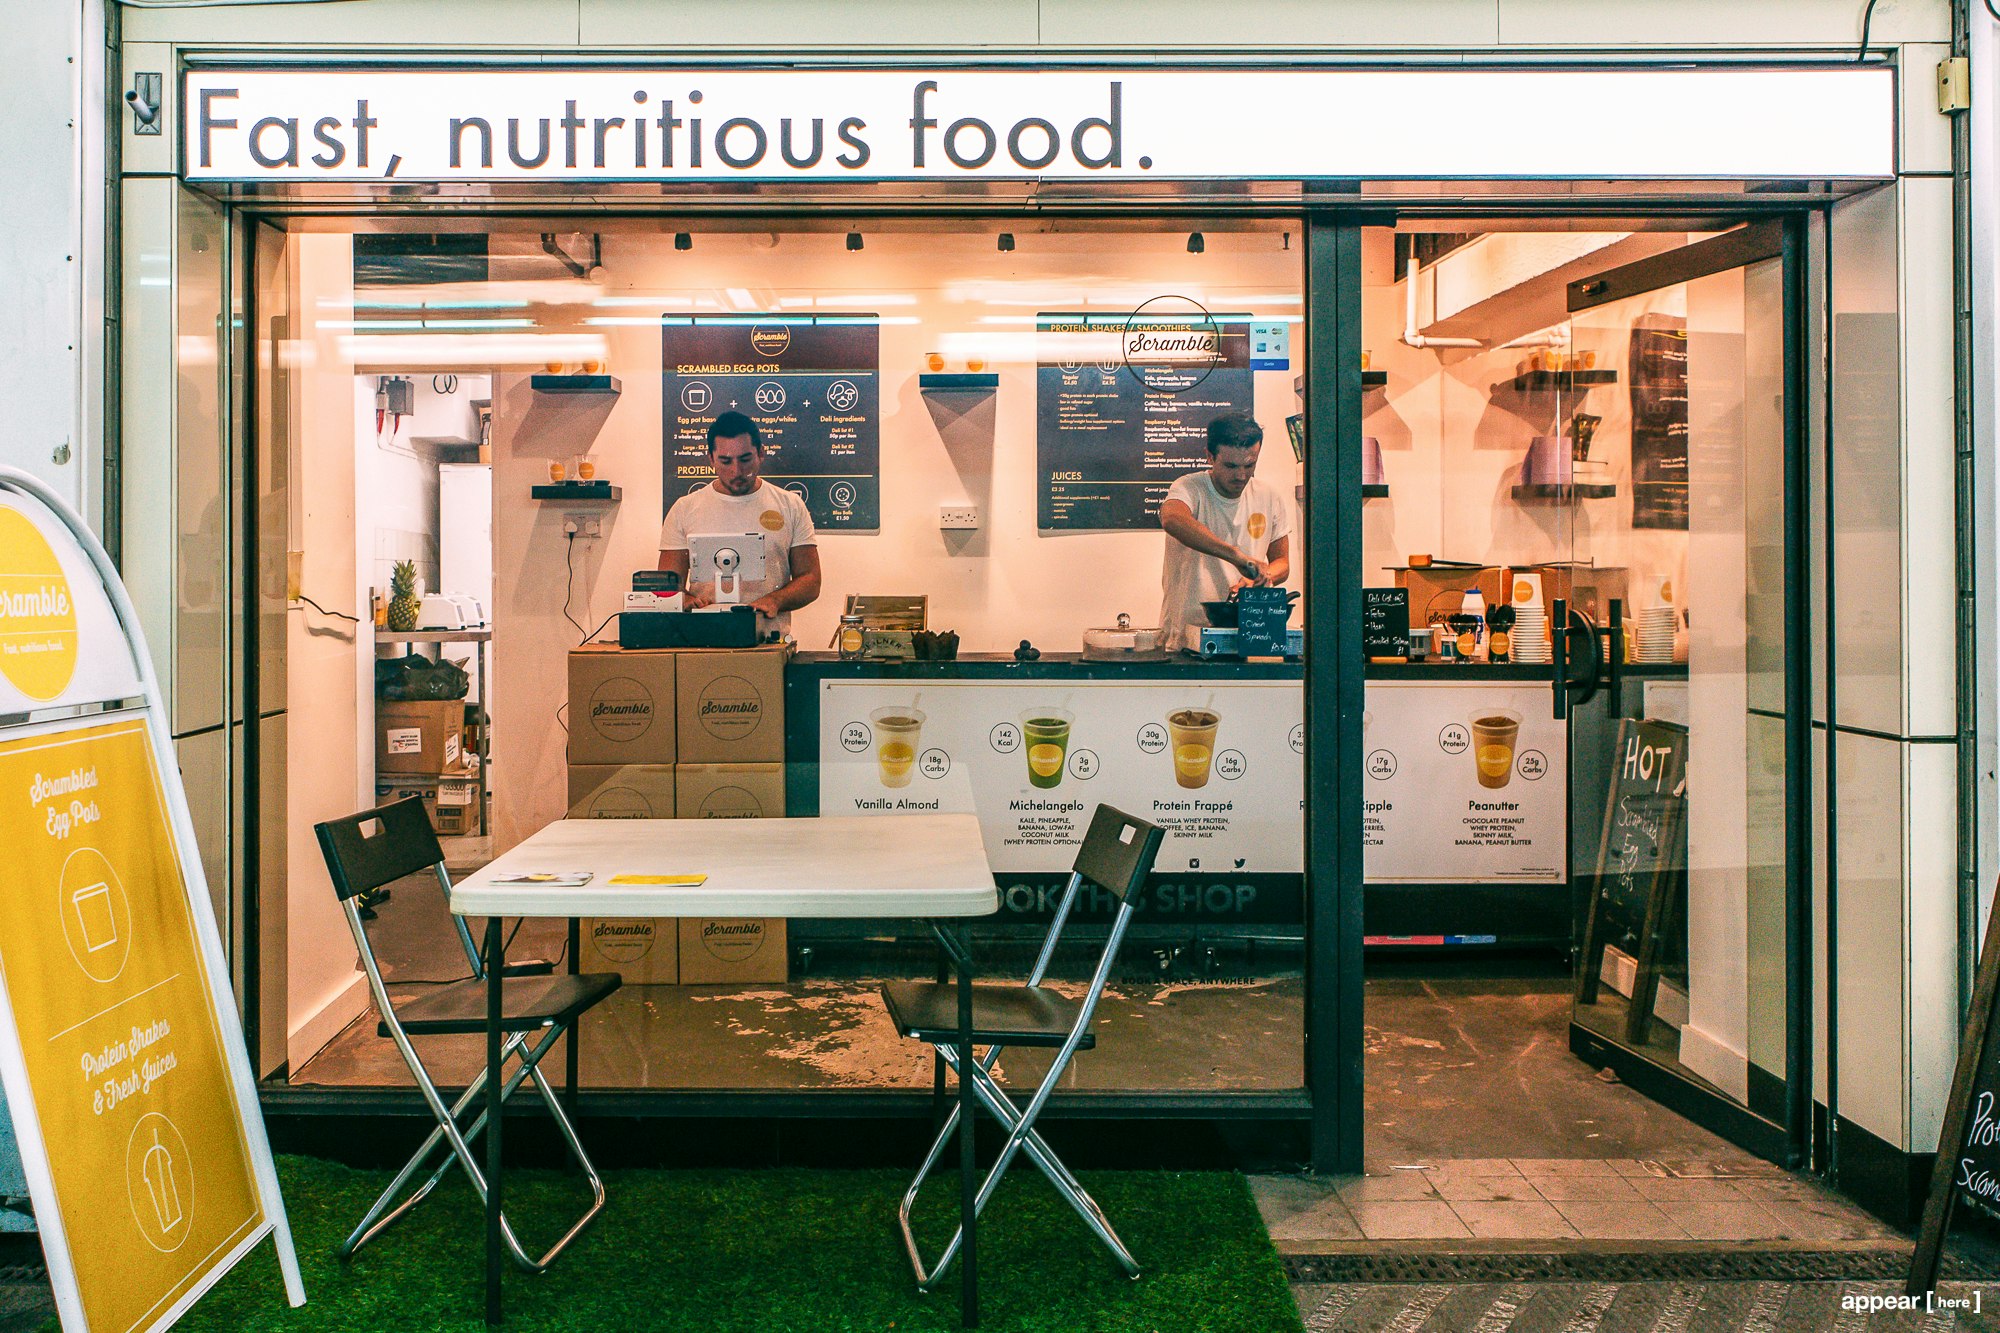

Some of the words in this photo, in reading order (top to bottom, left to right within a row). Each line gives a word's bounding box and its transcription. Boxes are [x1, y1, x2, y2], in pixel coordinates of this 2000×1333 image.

[200, 88, 402, 177] Fast,
[449, 91, 871, 169] nutritious
[909, 80, 1153, 170] food.
[1050, 324, 1089, 333] PROTEIN
[1091, 324, 1126, 333] SHAKES
[1137, 324, 1191, 332] SMOOTHIES
[1129, 333, 1214, 356] Scramble
[677, 364, 731, 374] SCRAMBLED
[733, 364, 754, 373] EGG
[756, 364, 780, 373] POTS
[677, 416, 689, 424] Egg
[691, 416, 701, 424] pot
[761, 415, 798, 424] eggs/whites
[833, 415, 866, 424] ingredients
[677, 466, 716, 475] PROTEIN
[1051, 471, 1082, 480] JUICES
[592, 702, 651, 717] Scramble
[702, 701, 759, 716] Scramble
[849, 729, 863, 739] 33g
[1145, 731, 1160, 740] 30g
[1448, 732, 1462, 740] 41g
[929, 756, 942, 764] 18g
[1079, 757, 1089, 765] 3g
[1225, 757, 1238, 766] 16g
[1376, 757, 1389, 766] 17g
[1525, 758, 1540, 766] 25g
[1623, 734, 1672, 793] HOT
[29, 765, 99, 809] Scrambled
[398, 790, 435, 799] SOLO
[855, 798, 893, 809] Vanilla
[896, 798, 939, 809] Almond
[1009, 799, 1084, 813] Michelangelo
[1153, 800, 1191, 810] Protein
[1194, 800, 1233, 813] Frappé
[1468, 800, 1520, 811] Peanutter
[46, 806, 72, 840] Egg
[70, 800, 101, 828] Pots
[1618, 795, 1660, 847] Scrambled
[1156, 883, 1257, 913] SHOP
[594, 923, 652, 937] Scramble
[704, 922, 762, 936] Scramble
[1164, 978, 1195, 986] SPACE,
[1198, 977, 1256, 985] ANYWHERE
[81, 1040, 128, 1082] Protein
[128, 1019, 171, 1062] Shakes
[93, 1089, 104, 1115] &
[104, 1069, 141, 1110] Fresh
[141, 1051, 178, 1095] Juices
[1968, 1091, 2000, 1148] Prot
[1956, 1157, 2000, 1203] Scram
